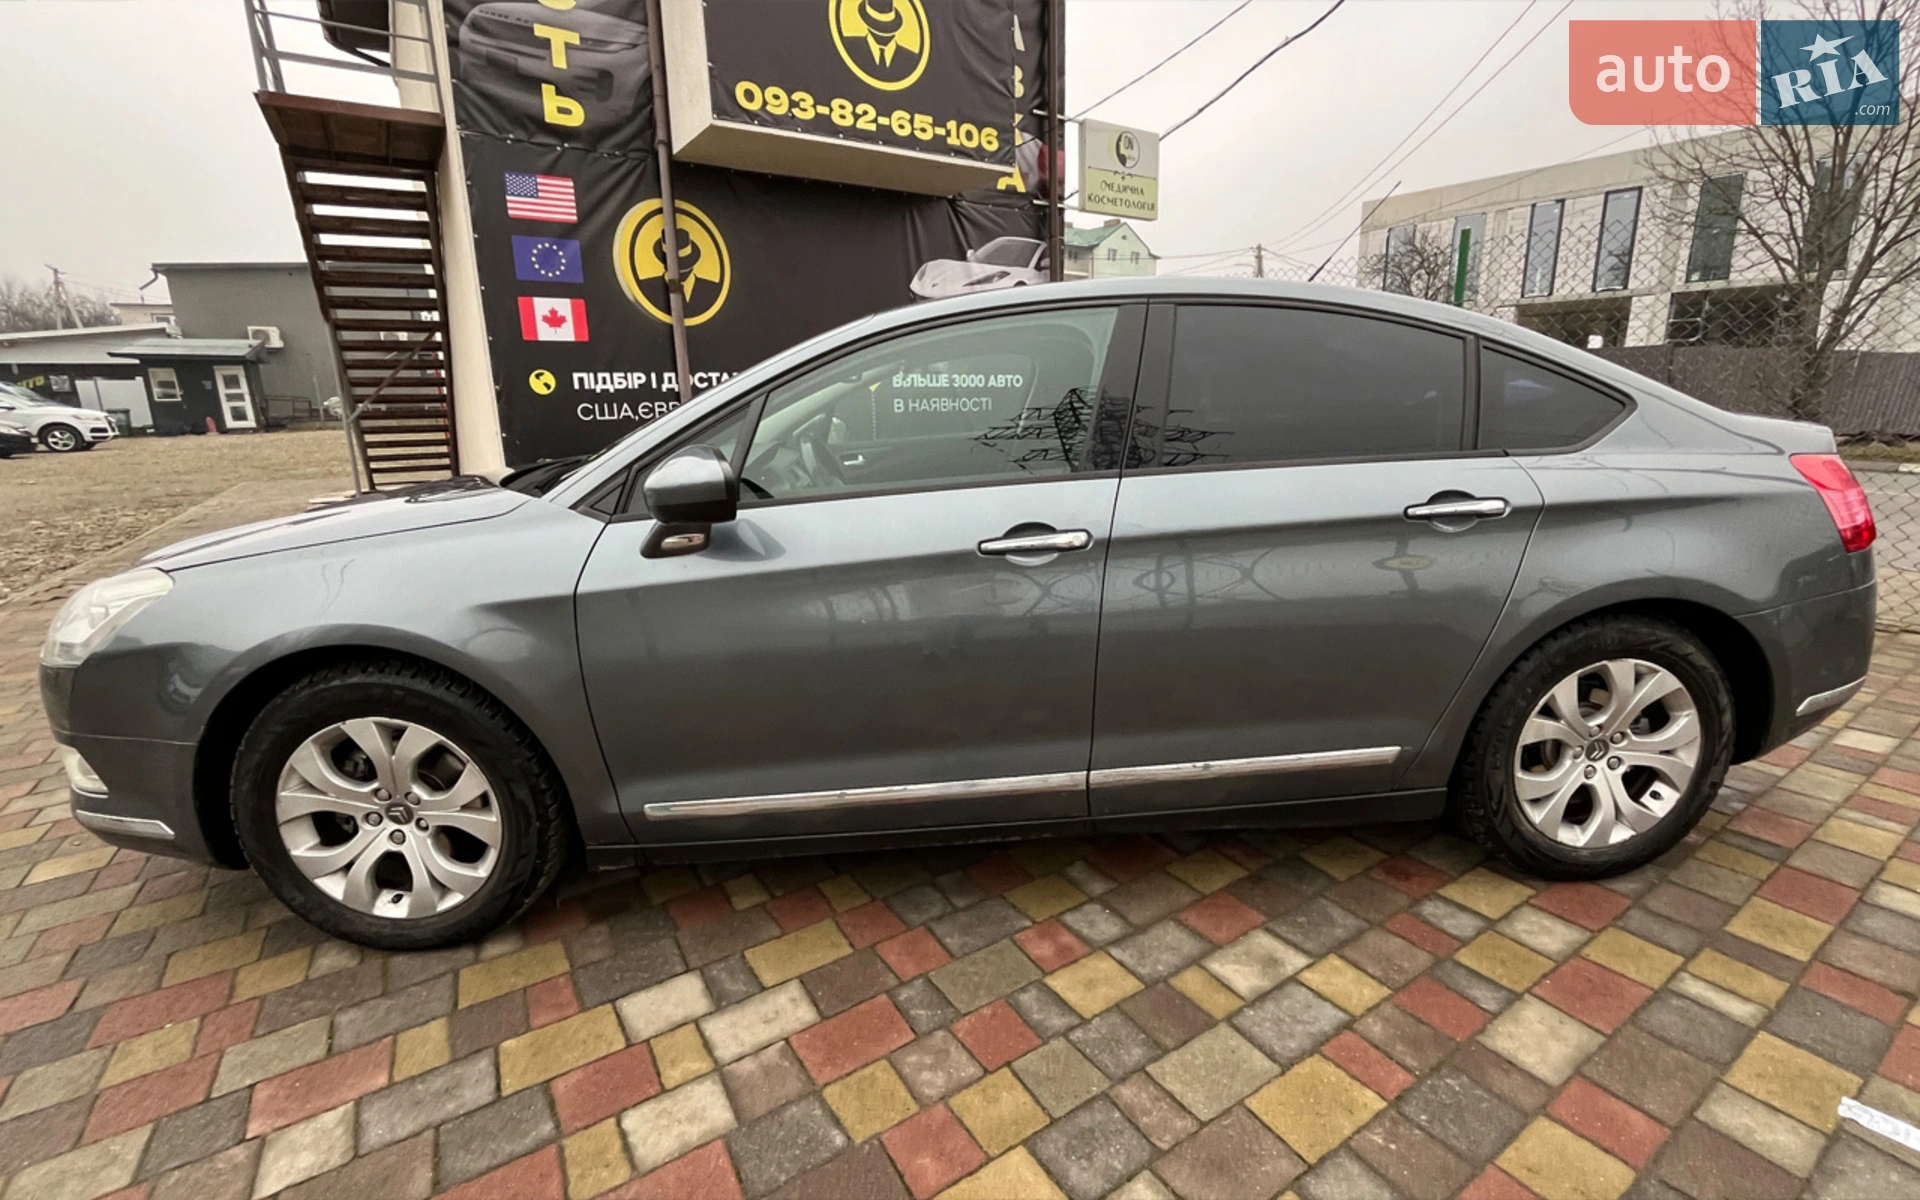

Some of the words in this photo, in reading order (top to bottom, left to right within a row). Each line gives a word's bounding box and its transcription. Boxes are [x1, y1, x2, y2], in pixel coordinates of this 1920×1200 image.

[735, 80, 999, 151] 093-82-65-106
[1087, 193, 1156, 211] КОСМЕТОЛОГІЯ
[572, 371, 647, 393] ПІДБІР
[952, 374, 985, 388] 3000
[988, 374, 1024, 388] АВТО
[893, 398, 905, 413] В
[908, 397, 993, 412] НАЯВНОСТІ
